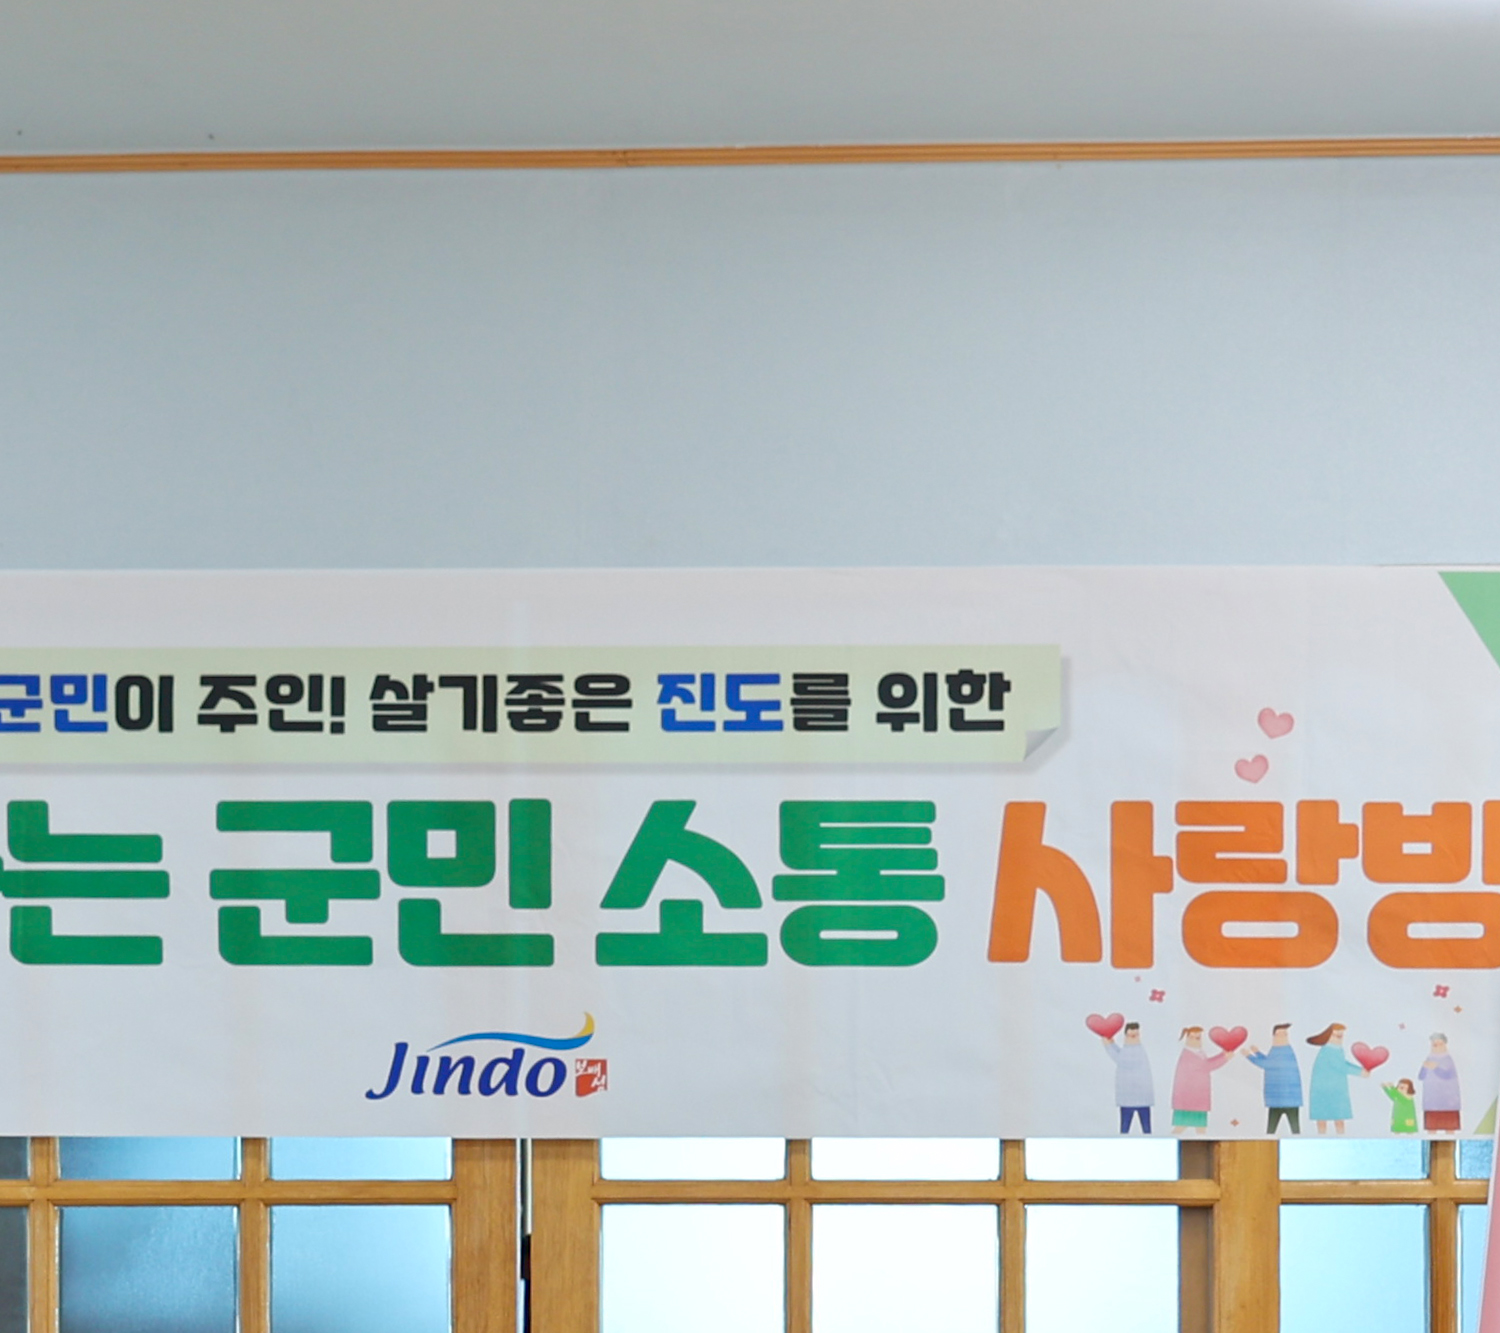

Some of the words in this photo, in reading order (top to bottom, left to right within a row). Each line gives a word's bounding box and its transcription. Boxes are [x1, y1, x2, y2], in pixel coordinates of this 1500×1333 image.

[197, 674, 346, 734] 주인!
[370, 673, 633, 733] 살기좋은
[657, 672, 852, 733] 진도를
[876, 669, 1011, 733] 위한
[210, 799, 555, 967] 군민
[596, 800, 945, 967] 소통
[365, 1042, 567, 1100] Jindo
